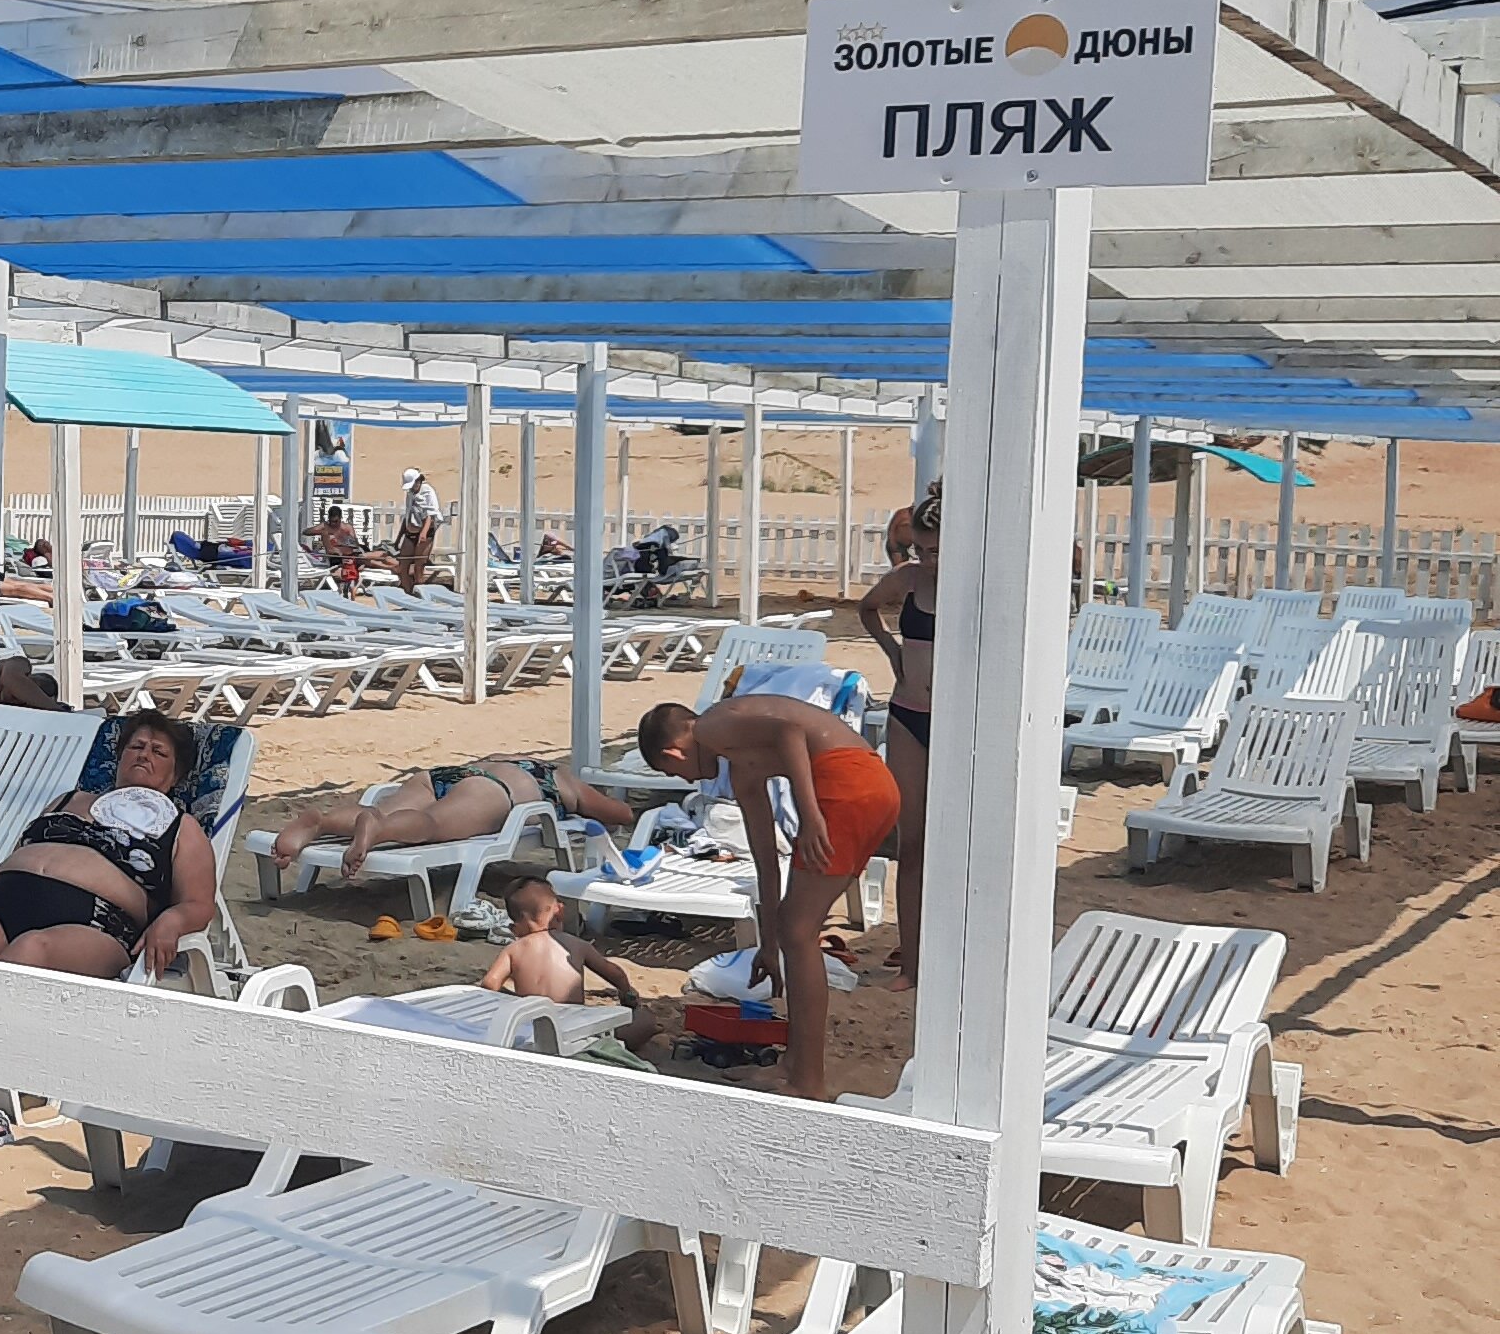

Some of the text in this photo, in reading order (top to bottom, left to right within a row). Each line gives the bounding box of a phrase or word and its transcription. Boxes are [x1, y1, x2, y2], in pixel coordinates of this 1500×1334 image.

[833, 25, 1194, 72] ЗОЛОТЫЕ ДЮНЫ
[882, 96, 1114, 159] ПЛЯЖ
